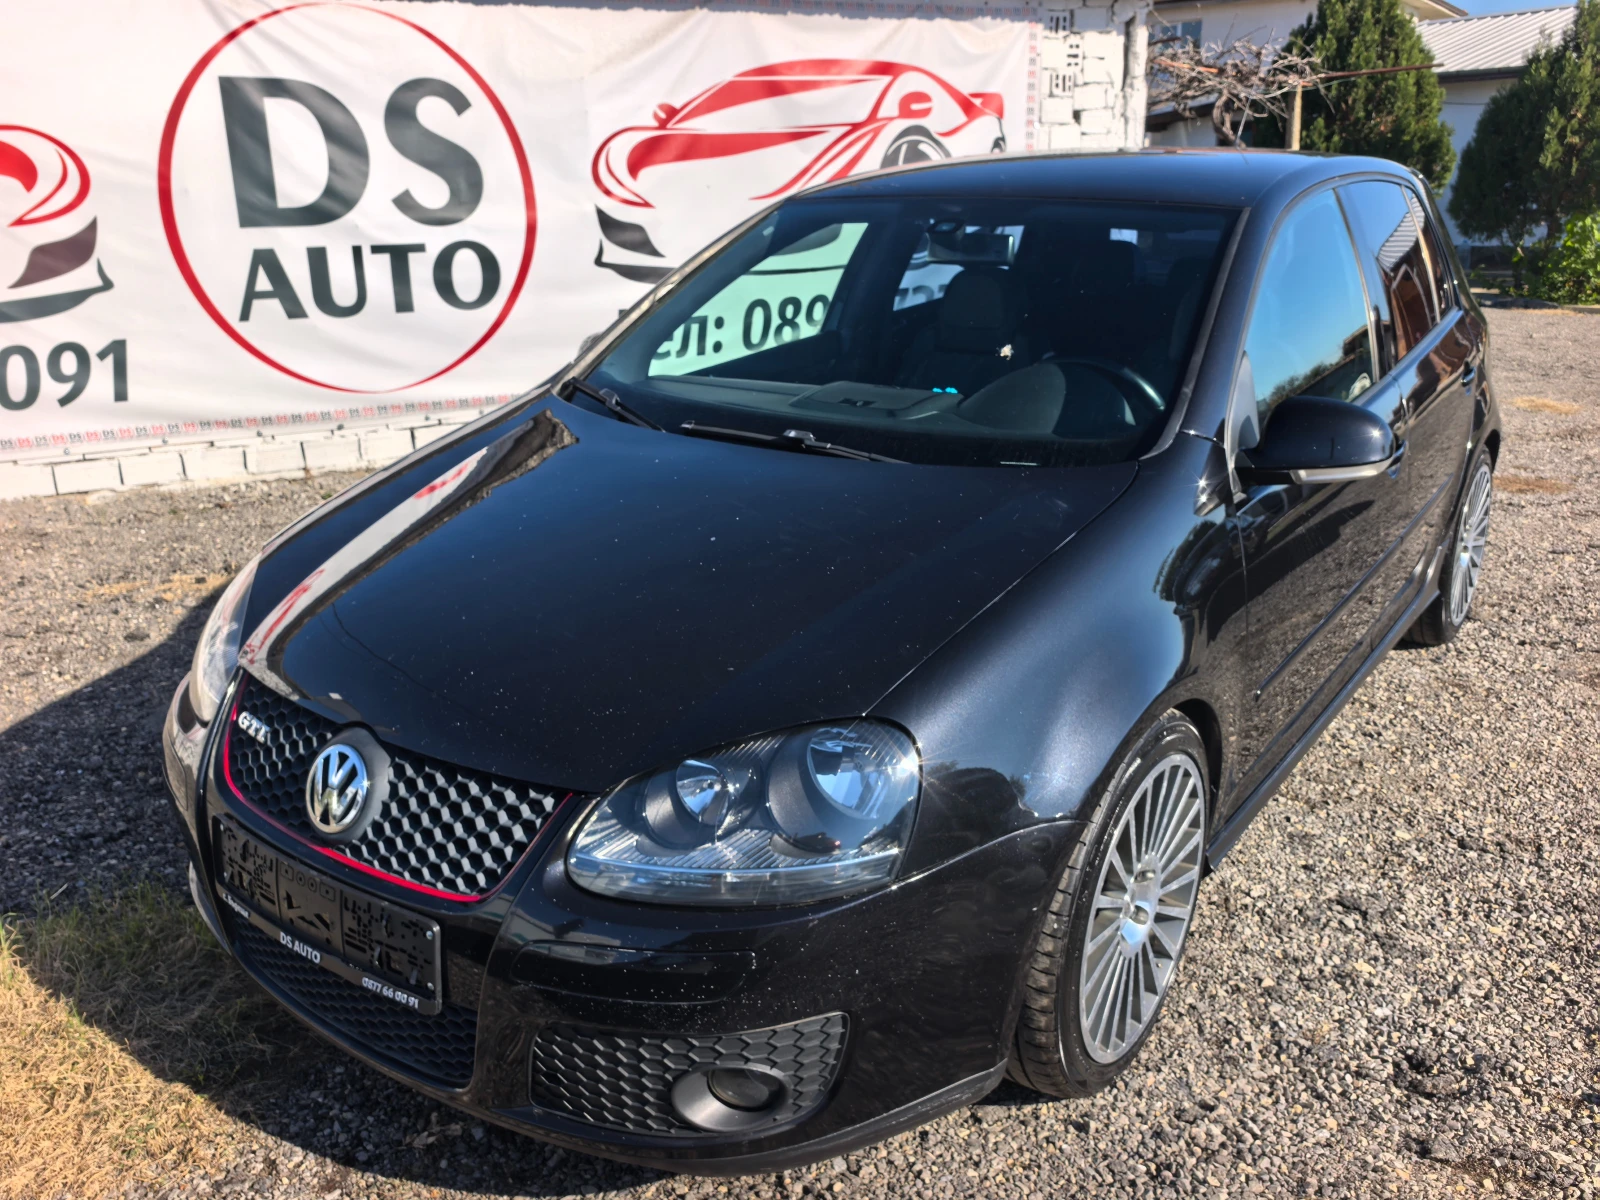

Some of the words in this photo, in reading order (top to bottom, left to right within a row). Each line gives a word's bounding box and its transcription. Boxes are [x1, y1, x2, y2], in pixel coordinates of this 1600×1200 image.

[218, 75, 484, 229] DS
[239, 240, 501, 322] AUTO
[652, 315, 725, 360] л:
[742, 293, 831, 351] 089
[0, 338, 128, 411] 091
[238, 711, 269, 744] GTI
[280, 931, 293, 949] DS
[293, 940, 321, 961] AUTO
[382, 986, 394, 998] 66
[394, 990, 408, 1004] 00
[408, 996, 419, 1009] 91
